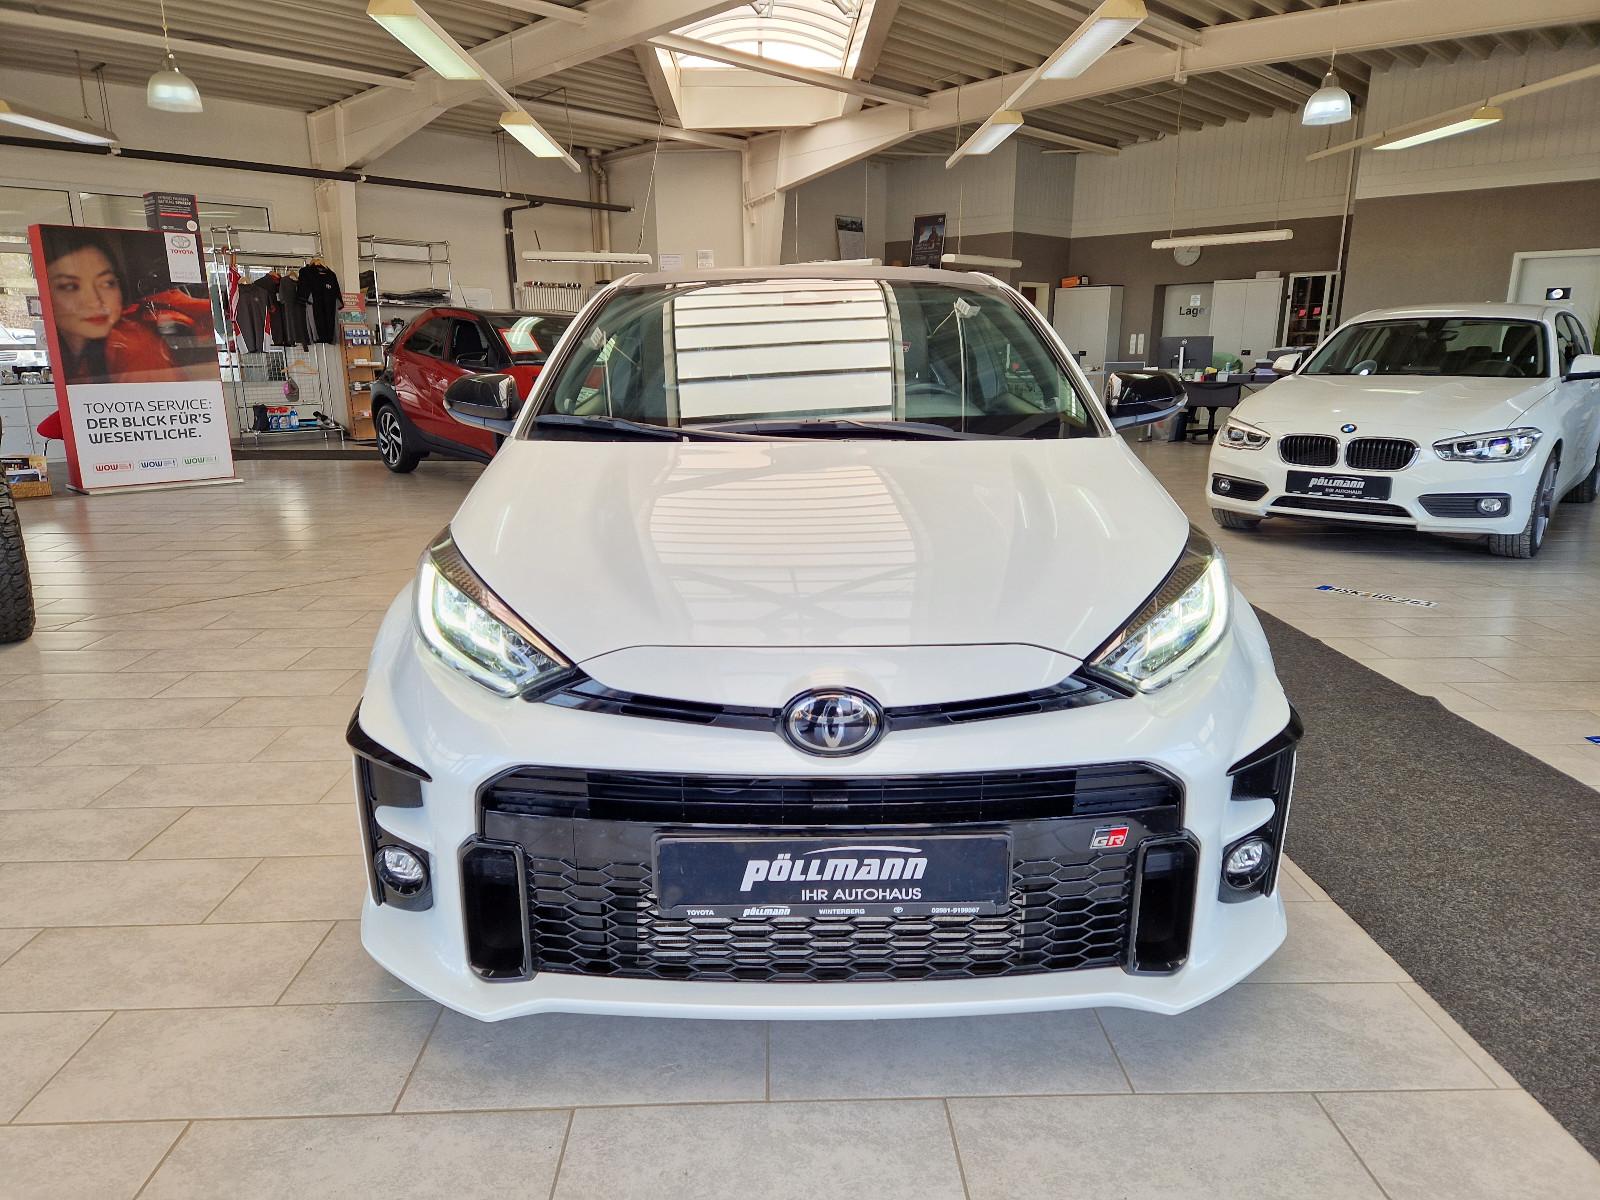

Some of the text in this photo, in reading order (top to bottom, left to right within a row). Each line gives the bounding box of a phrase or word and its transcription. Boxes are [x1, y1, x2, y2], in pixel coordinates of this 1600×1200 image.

[83, 399, 213, 415] TOYOTA SERVICE:
[86, 411, 212, 430] DER BLICK FÜR'S
[88, 427, 202, 445] WESENTLICHE.
[1093, 835, 1124, 847] GR
[801, 887, 922, 902] IHR AUTOHAUS
